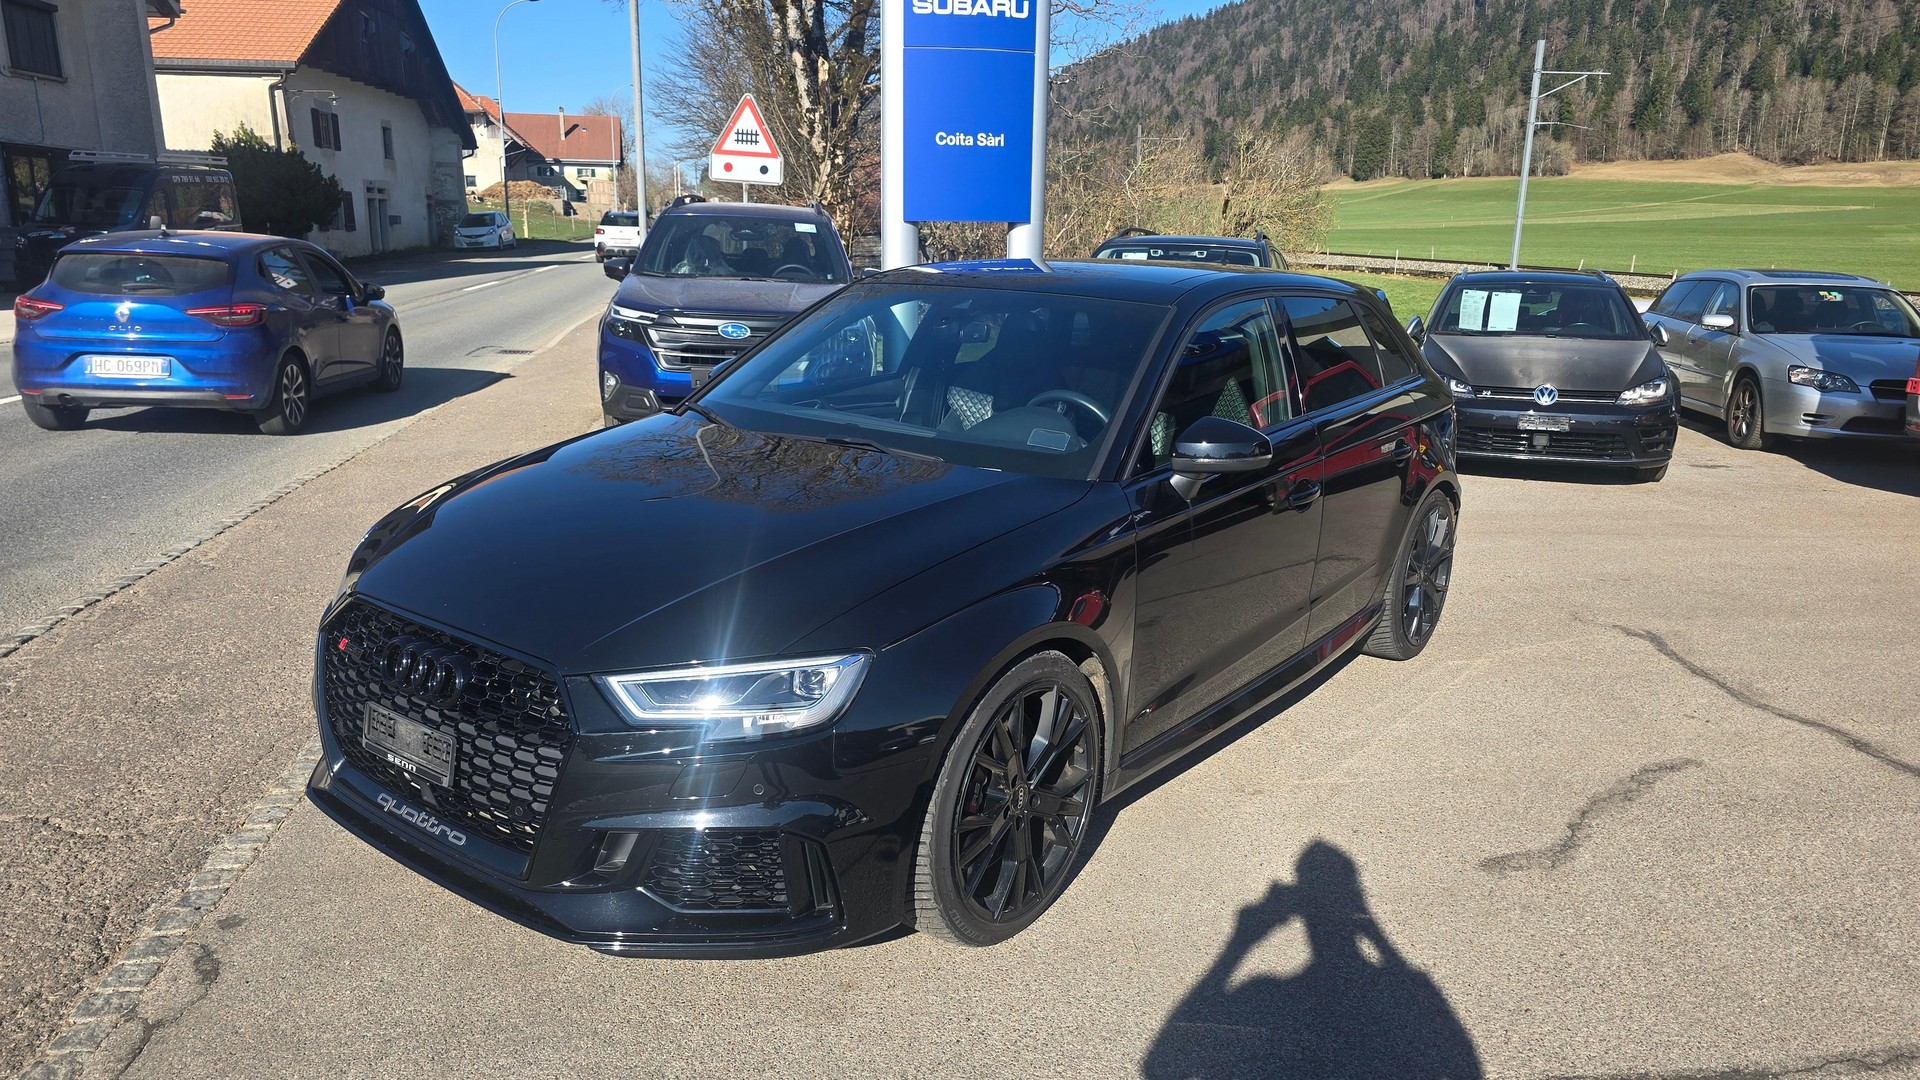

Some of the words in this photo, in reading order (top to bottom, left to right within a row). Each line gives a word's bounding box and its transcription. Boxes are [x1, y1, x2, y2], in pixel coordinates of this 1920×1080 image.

[912, 0, 1029, 19] SUBARU
[935, 131, 974, 146] Coita
[94, 359, 111, 372] HC
[376, 792, 467, 846] quattro
